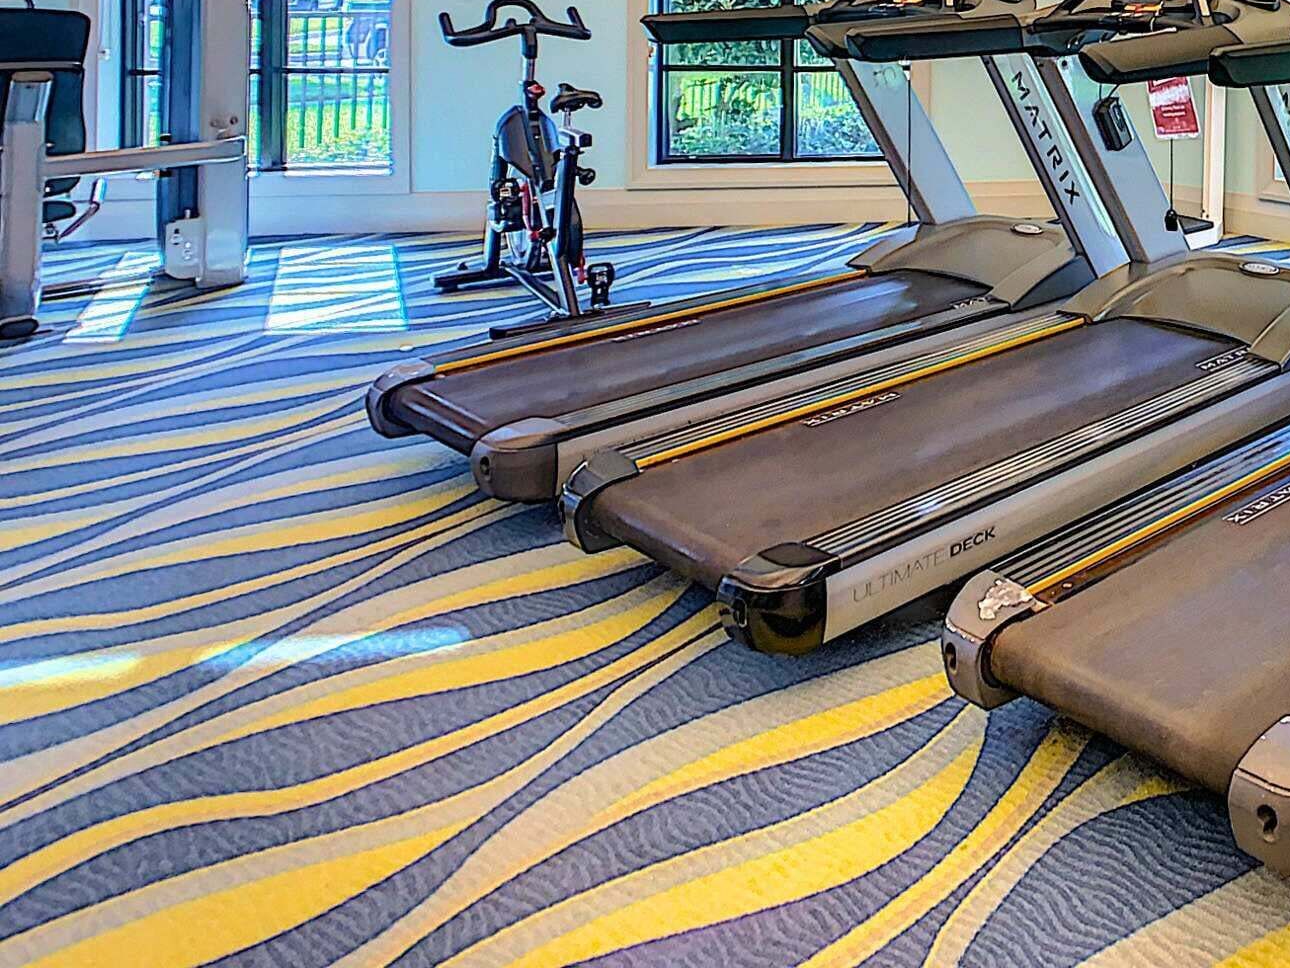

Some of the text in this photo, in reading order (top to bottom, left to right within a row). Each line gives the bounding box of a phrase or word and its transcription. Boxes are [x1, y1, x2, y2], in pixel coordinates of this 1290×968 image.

[1011, 71, 1081, 205] MATRIX
[851, 524, 997, 604] ULTIMATE DECK
